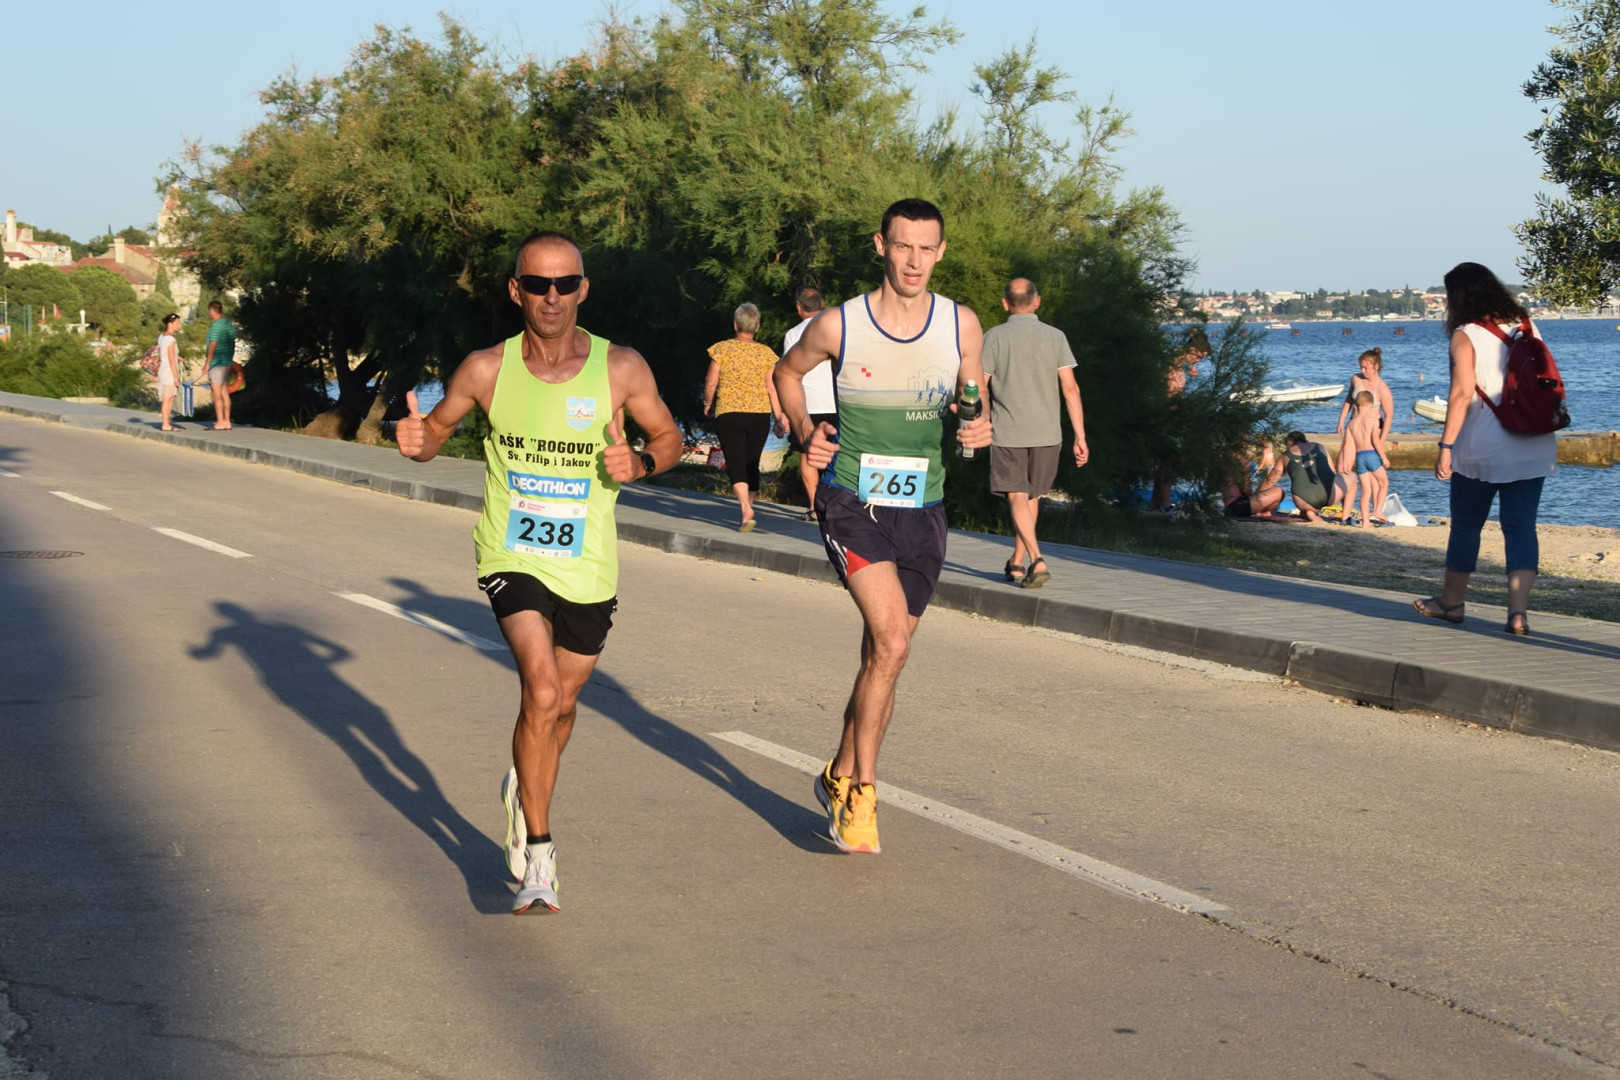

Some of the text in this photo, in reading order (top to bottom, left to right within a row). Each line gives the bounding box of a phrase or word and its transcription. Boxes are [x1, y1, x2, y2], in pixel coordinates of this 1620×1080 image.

[499, 432, 525, 449] AŠK
[507, 450, 591, 468] Sv. Filip i Jakov
[511, 475, 585, 496] DECATHLON
[869, 472, 918, 496] 265
[518, 517, 575, 547] 238
